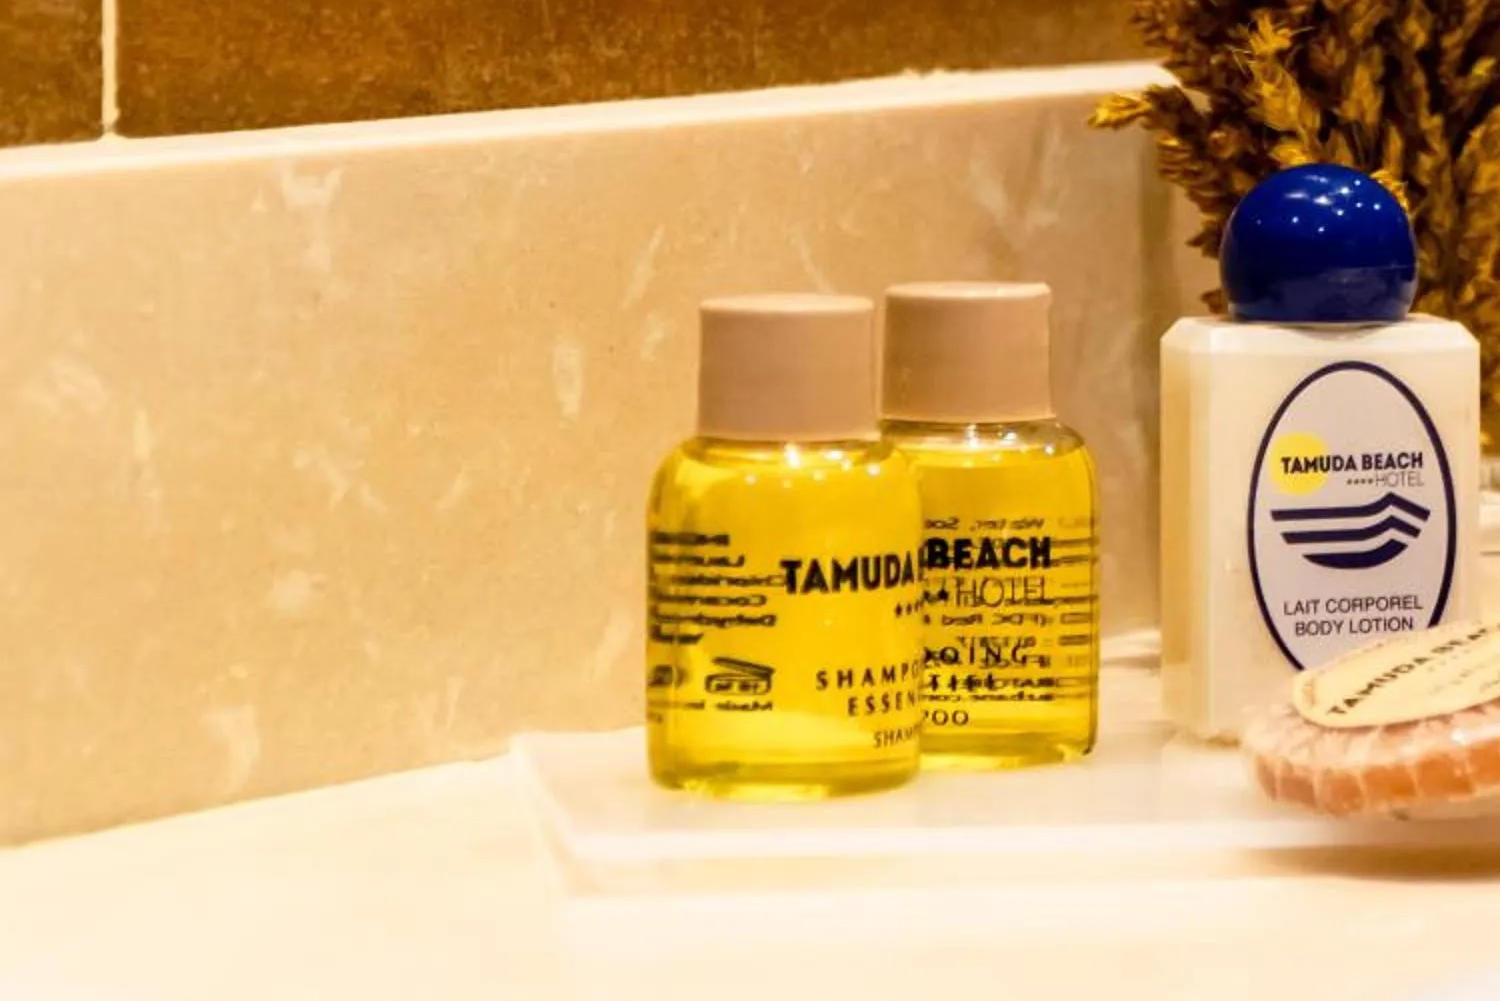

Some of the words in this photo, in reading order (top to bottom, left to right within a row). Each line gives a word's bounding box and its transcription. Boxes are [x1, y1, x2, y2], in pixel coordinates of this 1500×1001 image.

[1281, 455, 1357, 474] TAMUDA
[1361, 452, 1424, 470] BEACH
[1375, 470, 1425, 487] HOTEL
[925, 536, 1051, 569] BEACH
[779, 551, 915, 595] TAMUDA
[956, 576, 1048, 609] HOTEL
[1283, 599, 1320, 616] LAIT
[1325, 594, 1424, 615] CORPOREL
[1295, 620, 1344, 637] BODY
[1349, 616, 1414, 635] LOTION
[1327, 656, 1430, 715] TAMUDA
